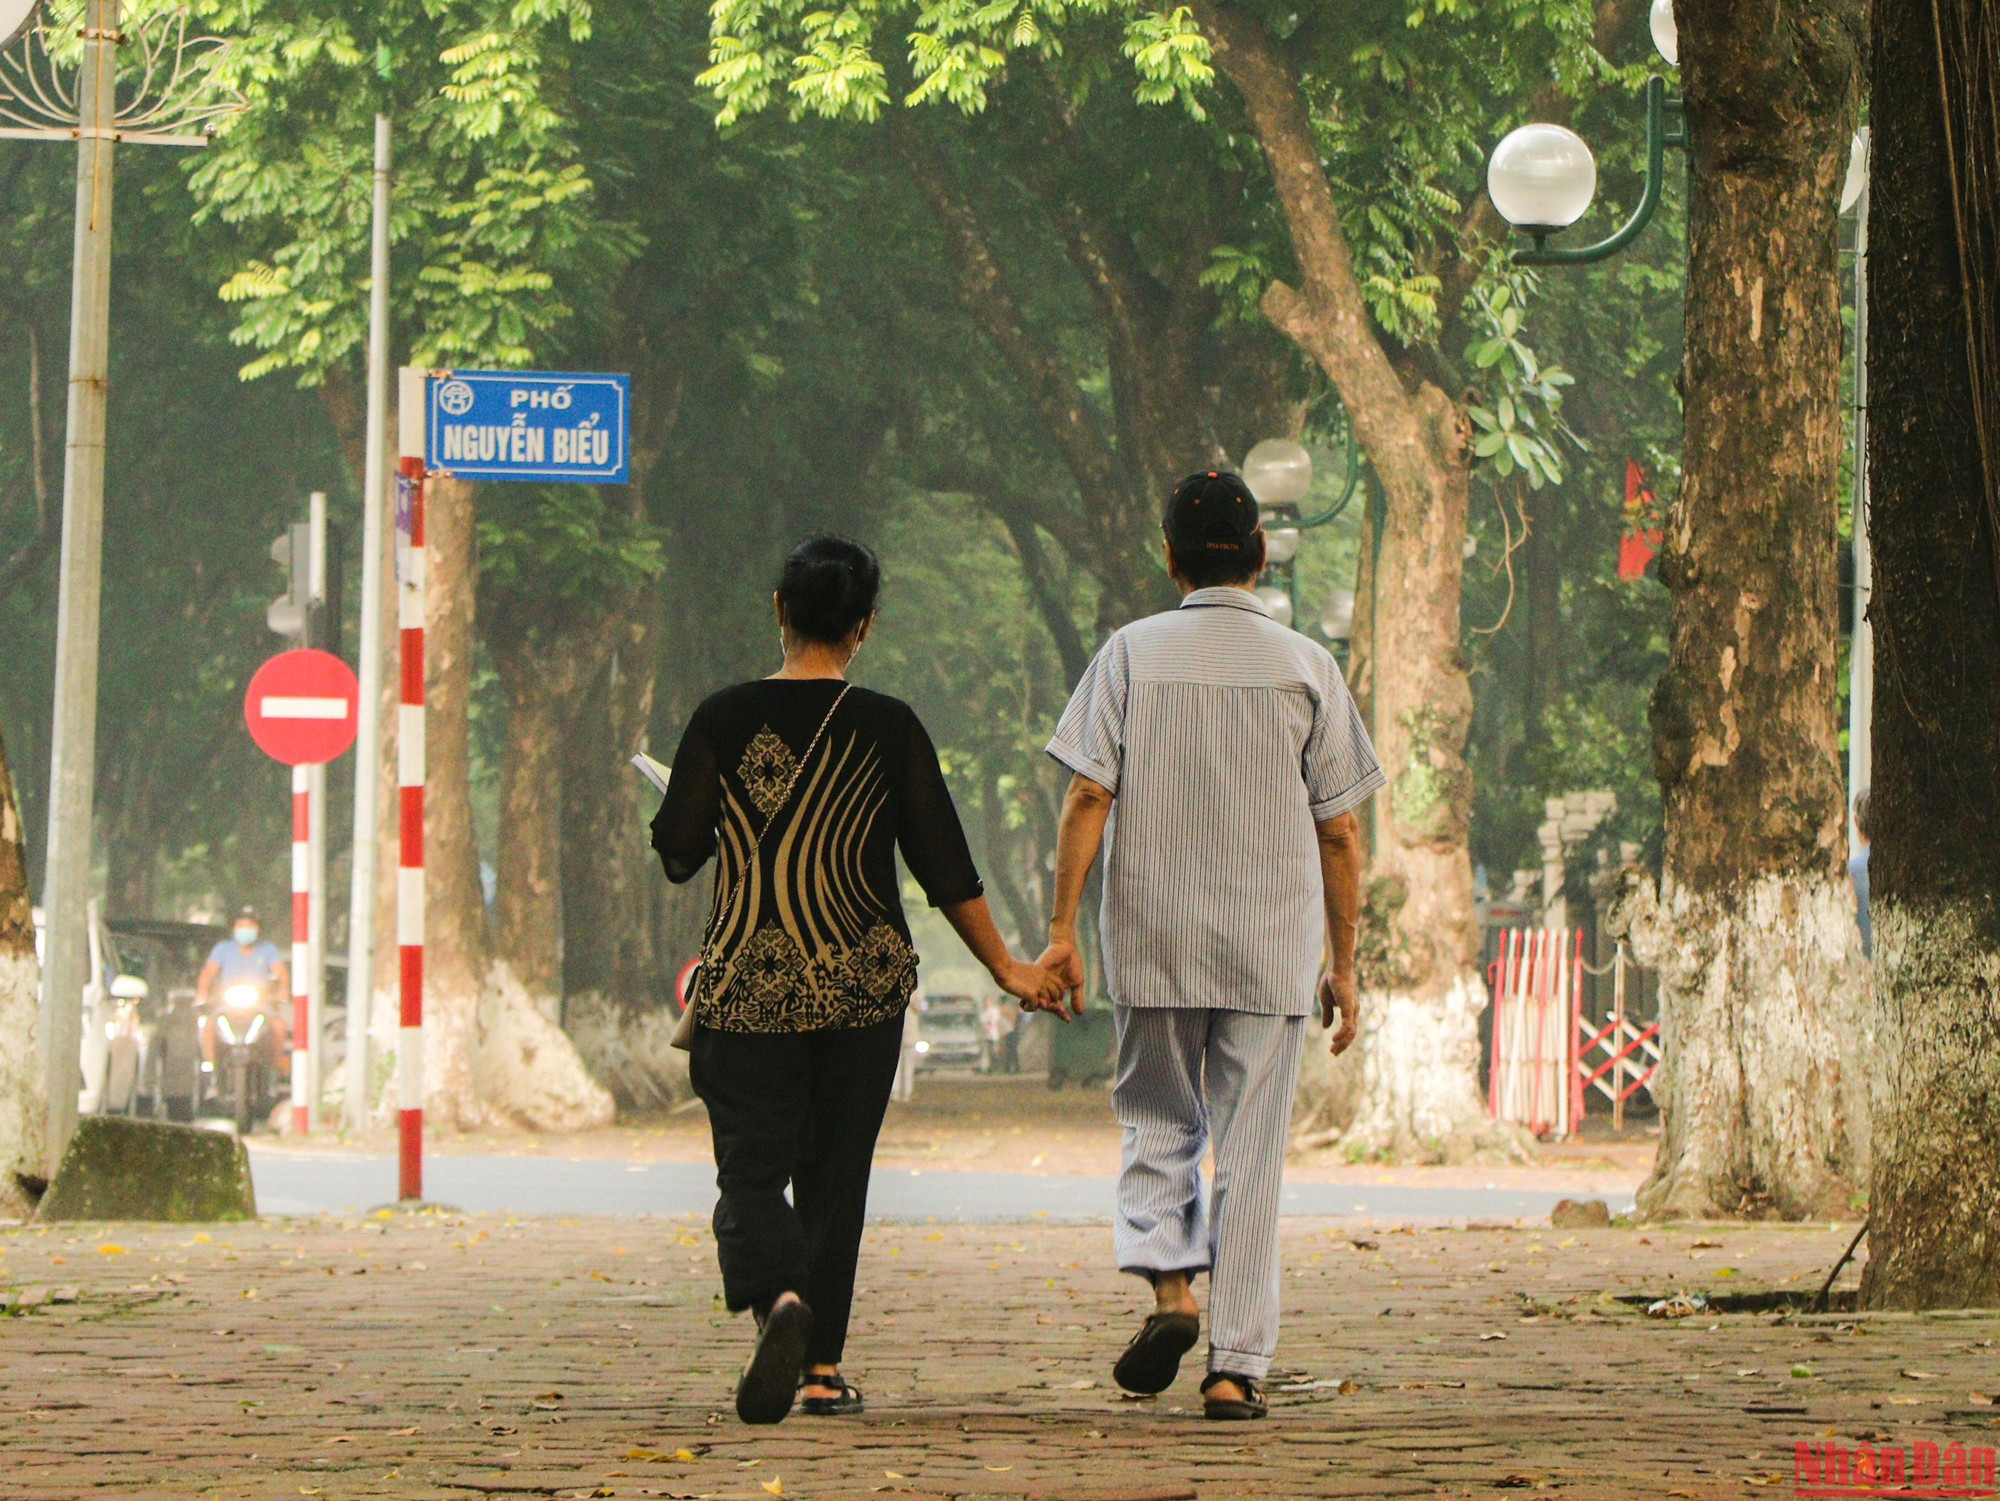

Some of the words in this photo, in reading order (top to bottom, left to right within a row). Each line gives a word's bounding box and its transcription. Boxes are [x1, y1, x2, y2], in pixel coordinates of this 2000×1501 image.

[511, 385, 574, 409] PHỐ
[443, 412, 545, 463] NGUYỄN
[553, 412, 609, 465] BIỂU
